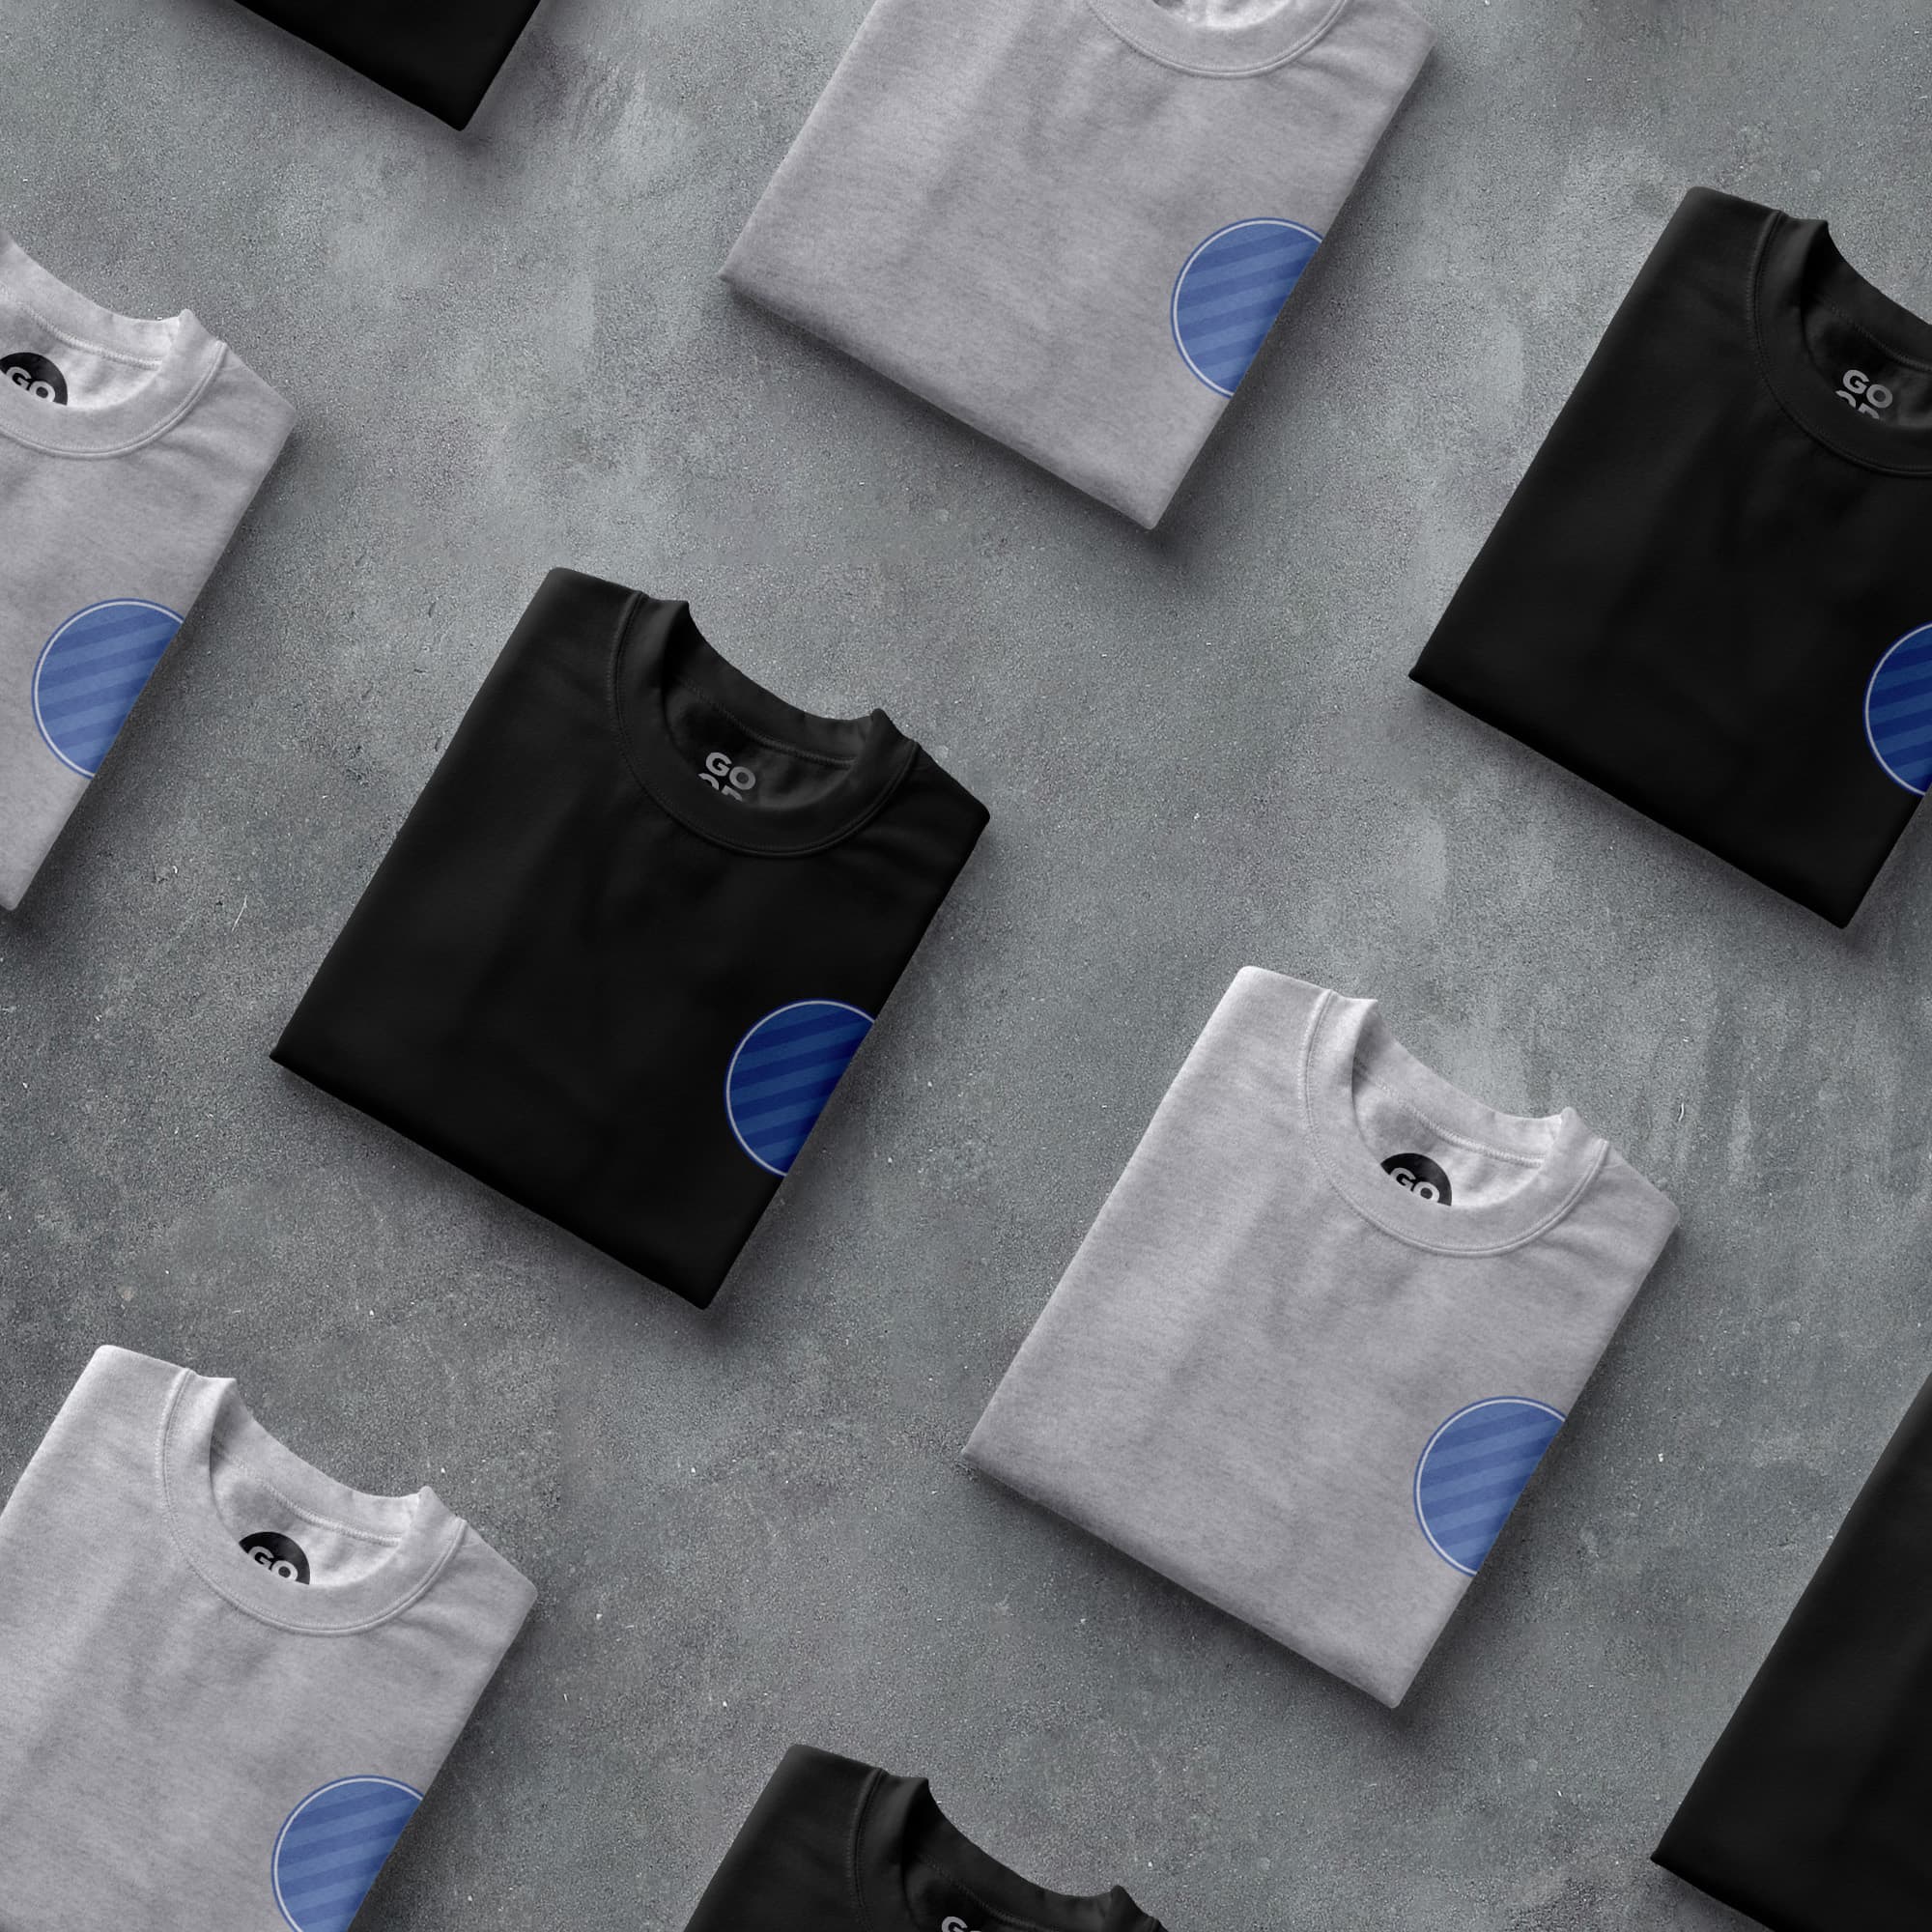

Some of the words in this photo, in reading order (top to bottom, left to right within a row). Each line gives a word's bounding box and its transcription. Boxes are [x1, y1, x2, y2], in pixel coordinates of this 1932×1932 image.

[1843, 369, 1893, 408] GO
[705, 752, 756, 790] GO
[941, 1916, 982, 1932] G
